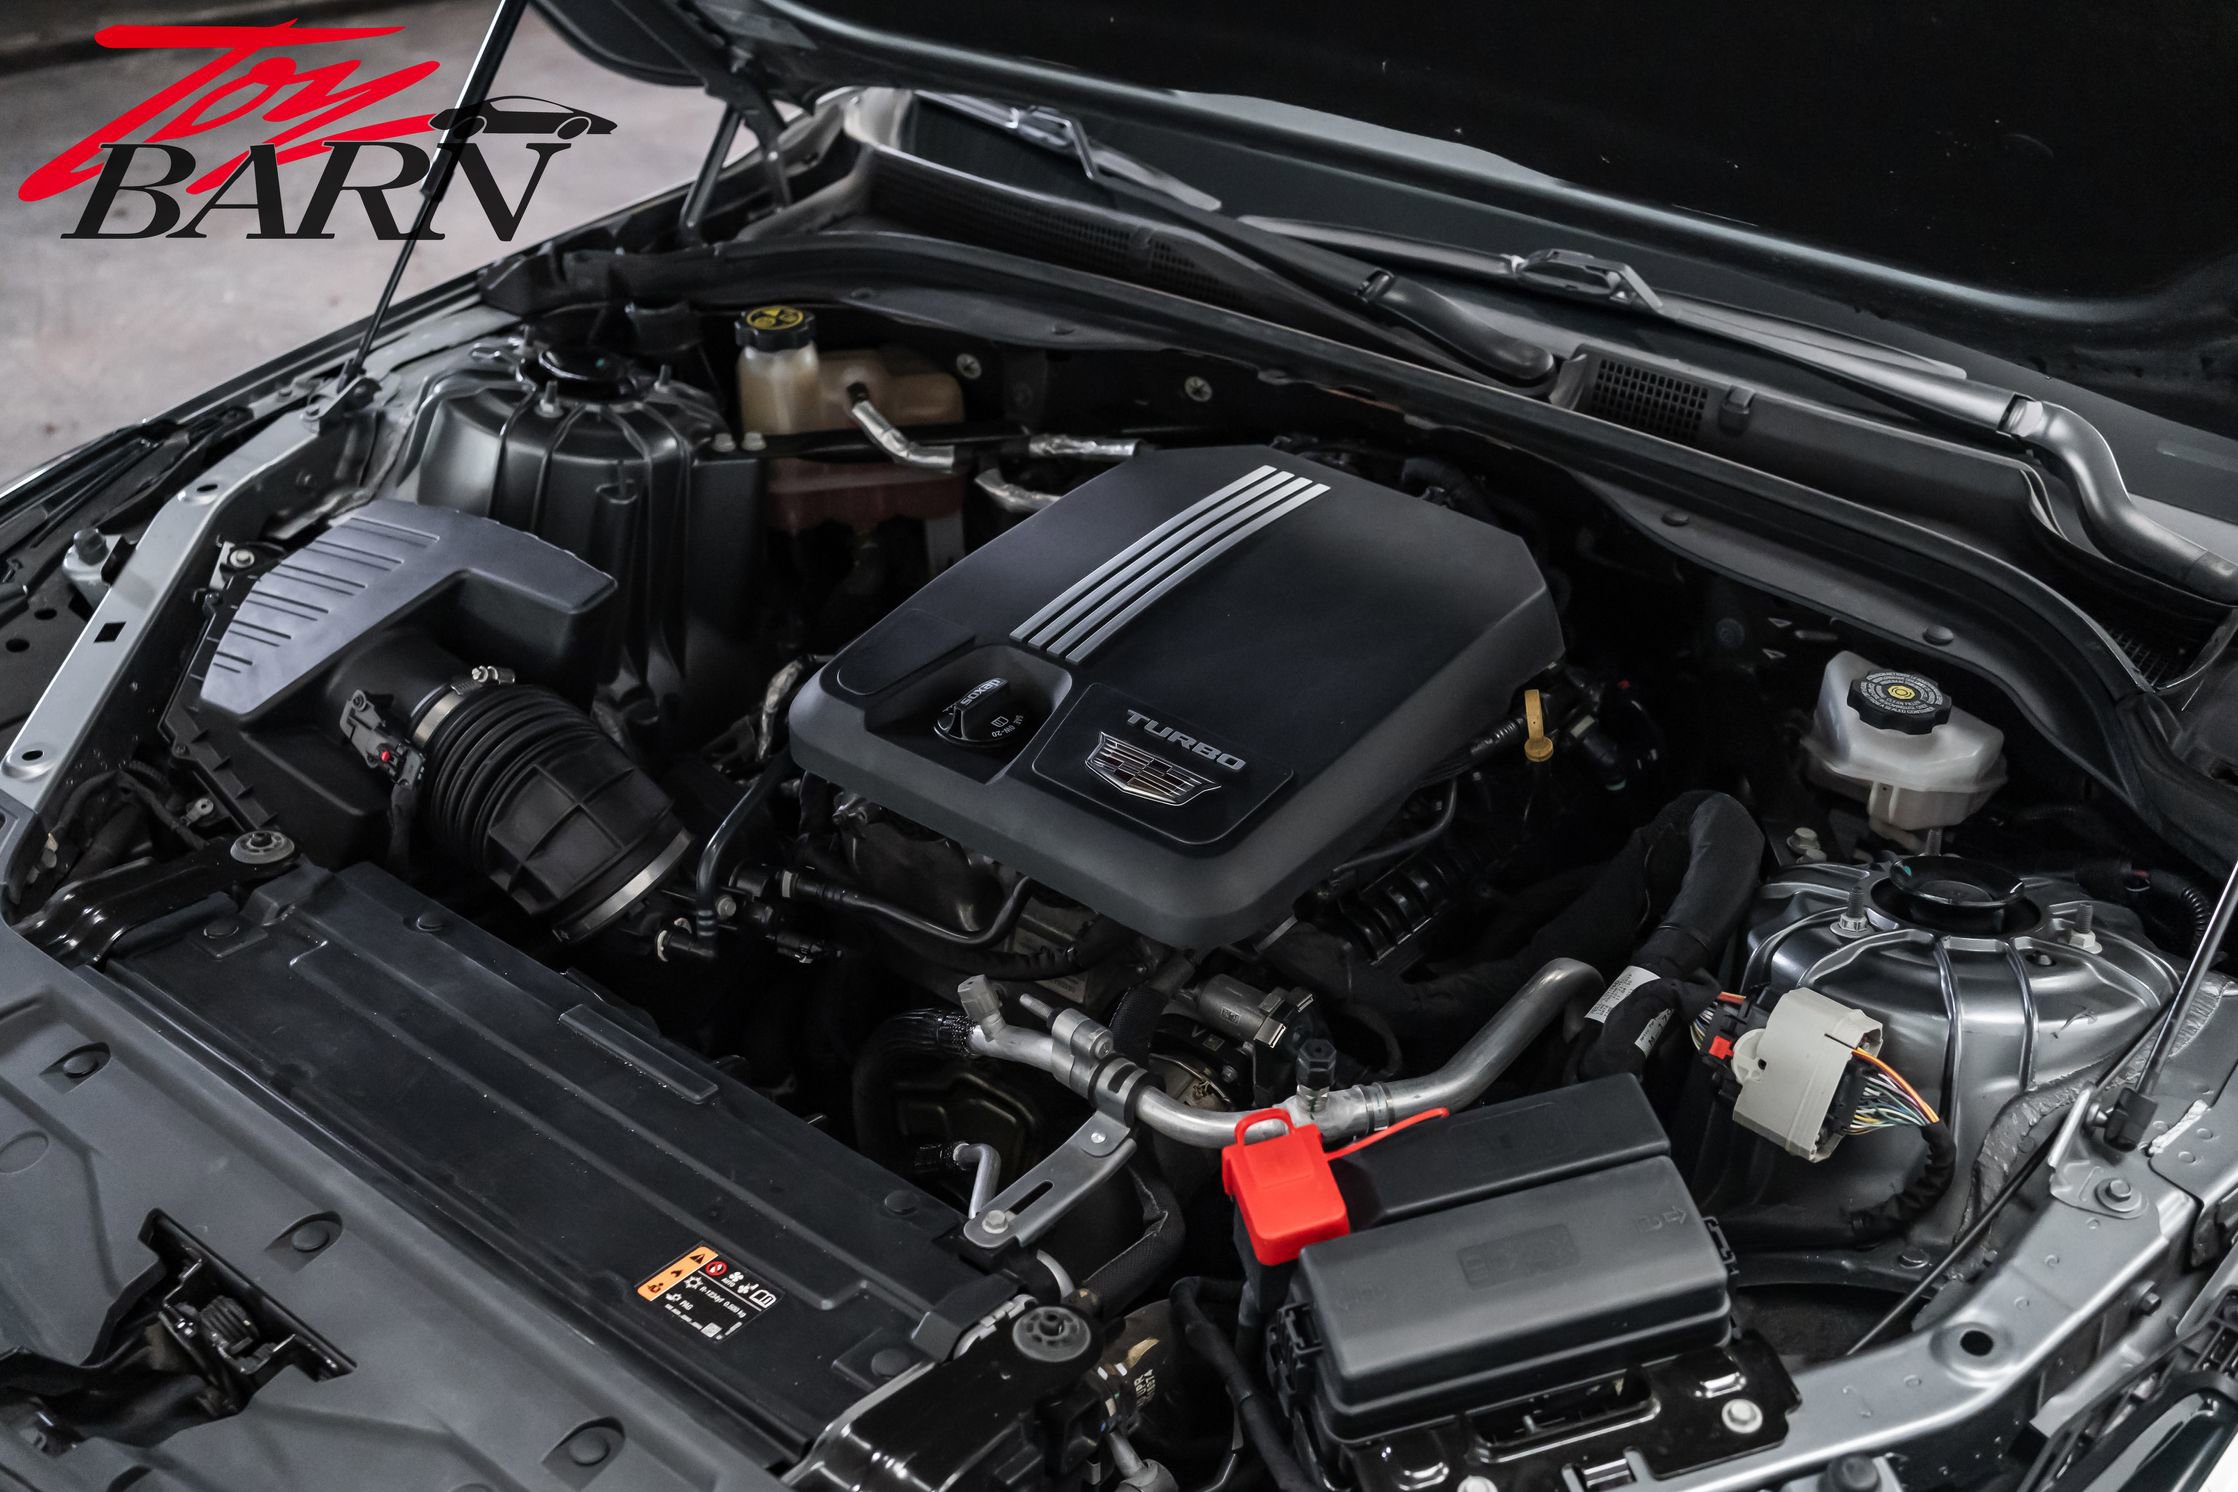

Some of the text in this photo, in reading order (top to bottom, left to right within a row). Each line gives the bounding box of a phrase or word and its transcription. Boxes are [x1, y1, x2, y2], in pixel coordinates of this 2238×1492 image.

[960, 679, 1001, 706] dexos
[1127, 709, 1246, 772] TURBO
[680, 1300, 694, 1311] PAG
